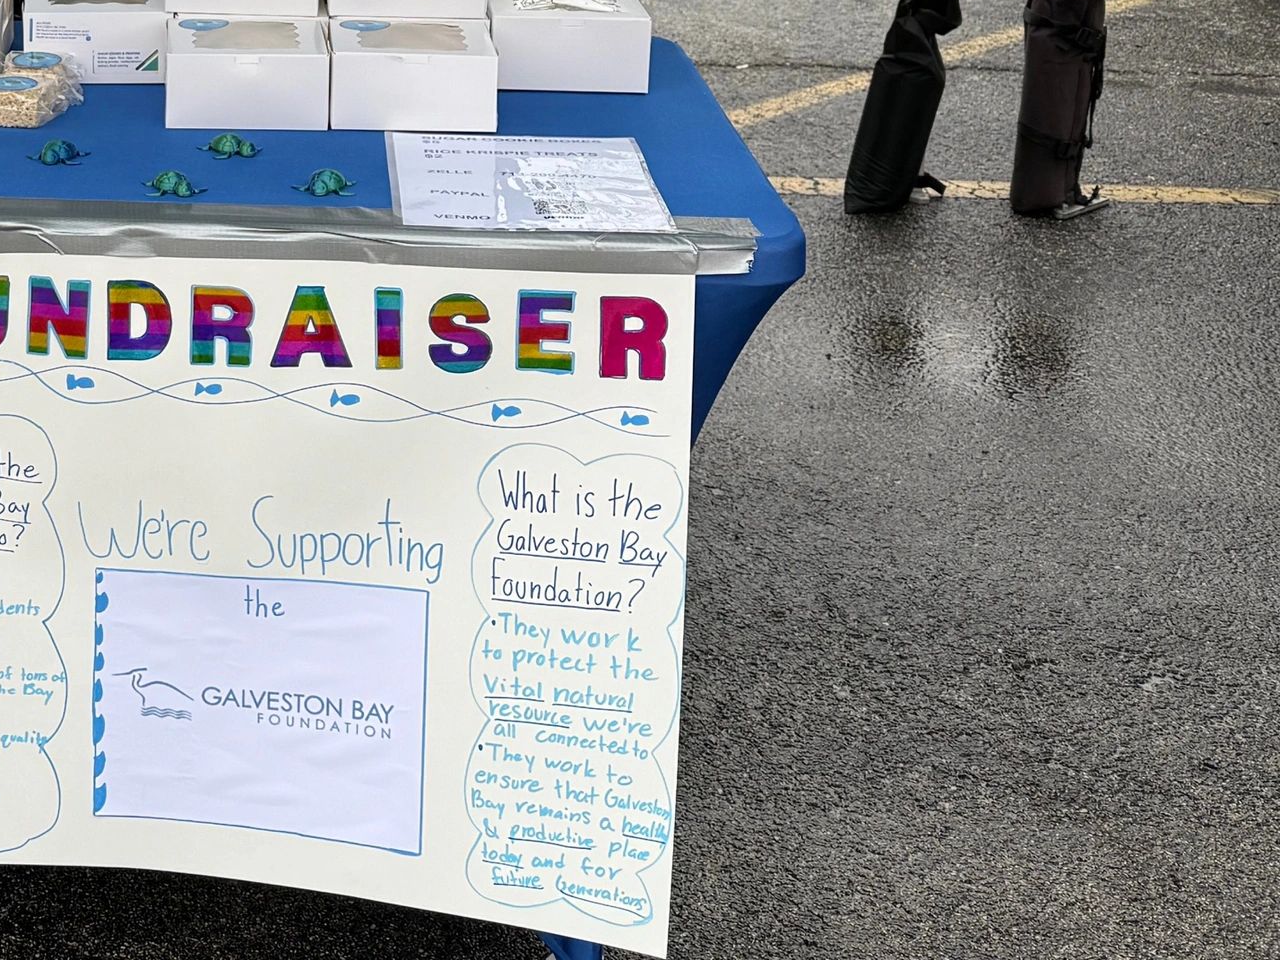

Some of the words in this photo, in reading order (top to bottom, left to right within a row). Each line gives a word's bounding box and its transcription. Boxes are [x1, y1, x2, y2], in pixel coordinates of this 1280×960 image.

[430, 189, 490, 198] PAYPAL
[498, 469, 560, 513] What
[577, 485, 595, 517] is
[608, 478, 662, 520] the
[78, 499, 210, 560] We're
[247, 495, 443, 584] Supporting
[497, 519, 609, 560] Galveston
[619, 530, 667, 577] Bay
[244, 585, 285, 617] the
[491, 557, 645, 614] Foundation?
[560, 627, 642, 652] work
[482, 639, 502, 660] to
[512, 648, 597, 673] protect
[610, 655, 659, 681] the
[23, 683, 54, 705] Bay
[201, 686, 343, 717] GALVESTON
[351, 700, 394, 724] BAY
[553, 686, 634, 710] natural
[257, 713, 392, 739] FOUNDATION
[489, 700, 572, 725] resource
[584, 717, 653, 737] we're
[494, 723, 516, 738] all
[535, 730, 628, 756] connected
[634, 742, 649, 760] to
[545, 757, 596, 778] work
[607, 764, 632, 786] to
[472, 788, 505, 819] Bay
[516, 801, 591, 825] remains
[600, 817, 615, 832] a
[475, 770, 543, 793] ensure
[555, 779, 600, 805] that
[604, 788, 670, 820] Galveston
[510, 824, 596, 848] productive
[481, 842, 523, 871] today
[532, 853, 565, 869] and
[581, 857, 622, 880] for
[492, 866, 541, 887] future
